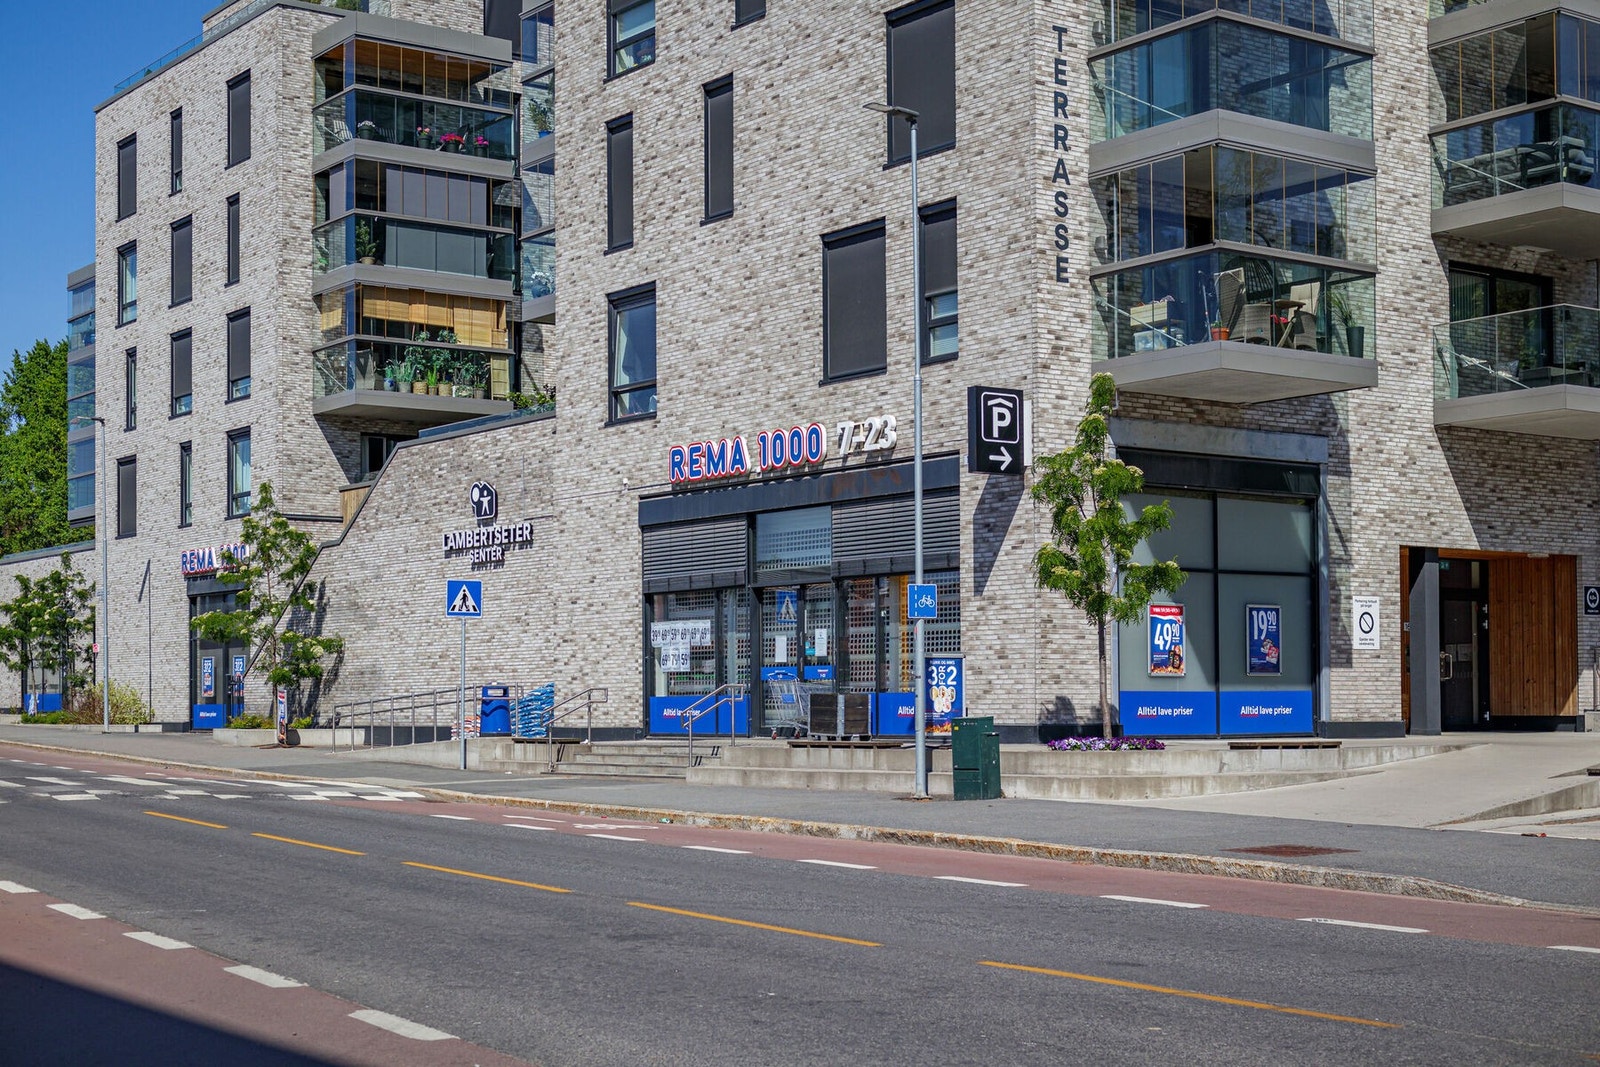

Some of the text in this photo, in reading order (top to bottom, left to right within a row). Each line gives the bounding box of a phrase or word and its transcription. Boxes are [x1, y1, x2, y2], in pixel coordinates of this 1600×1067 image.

[1051, 24, 1070, 284] TERRASSE
[669, 414, 897, 484] REMA 1000 7-23
[442, 522, 532, 551] LAMBERTSETER
[181, 546, 216, 575] REMA
[469, 545, 503, 563] SENTER
[1154, 623, 1172, 651] 49
[1251, 610, 1268, 640] 19
[928, 666, 958, 686] 3 FOR 2
[663, 708, 676, 717] Alltid
[897, 705, 915, 715] Alltid
[1137, 706, 1194, 717] Alltid lave priser
[1240, 705, 1293, 716] Alltid lave priser
